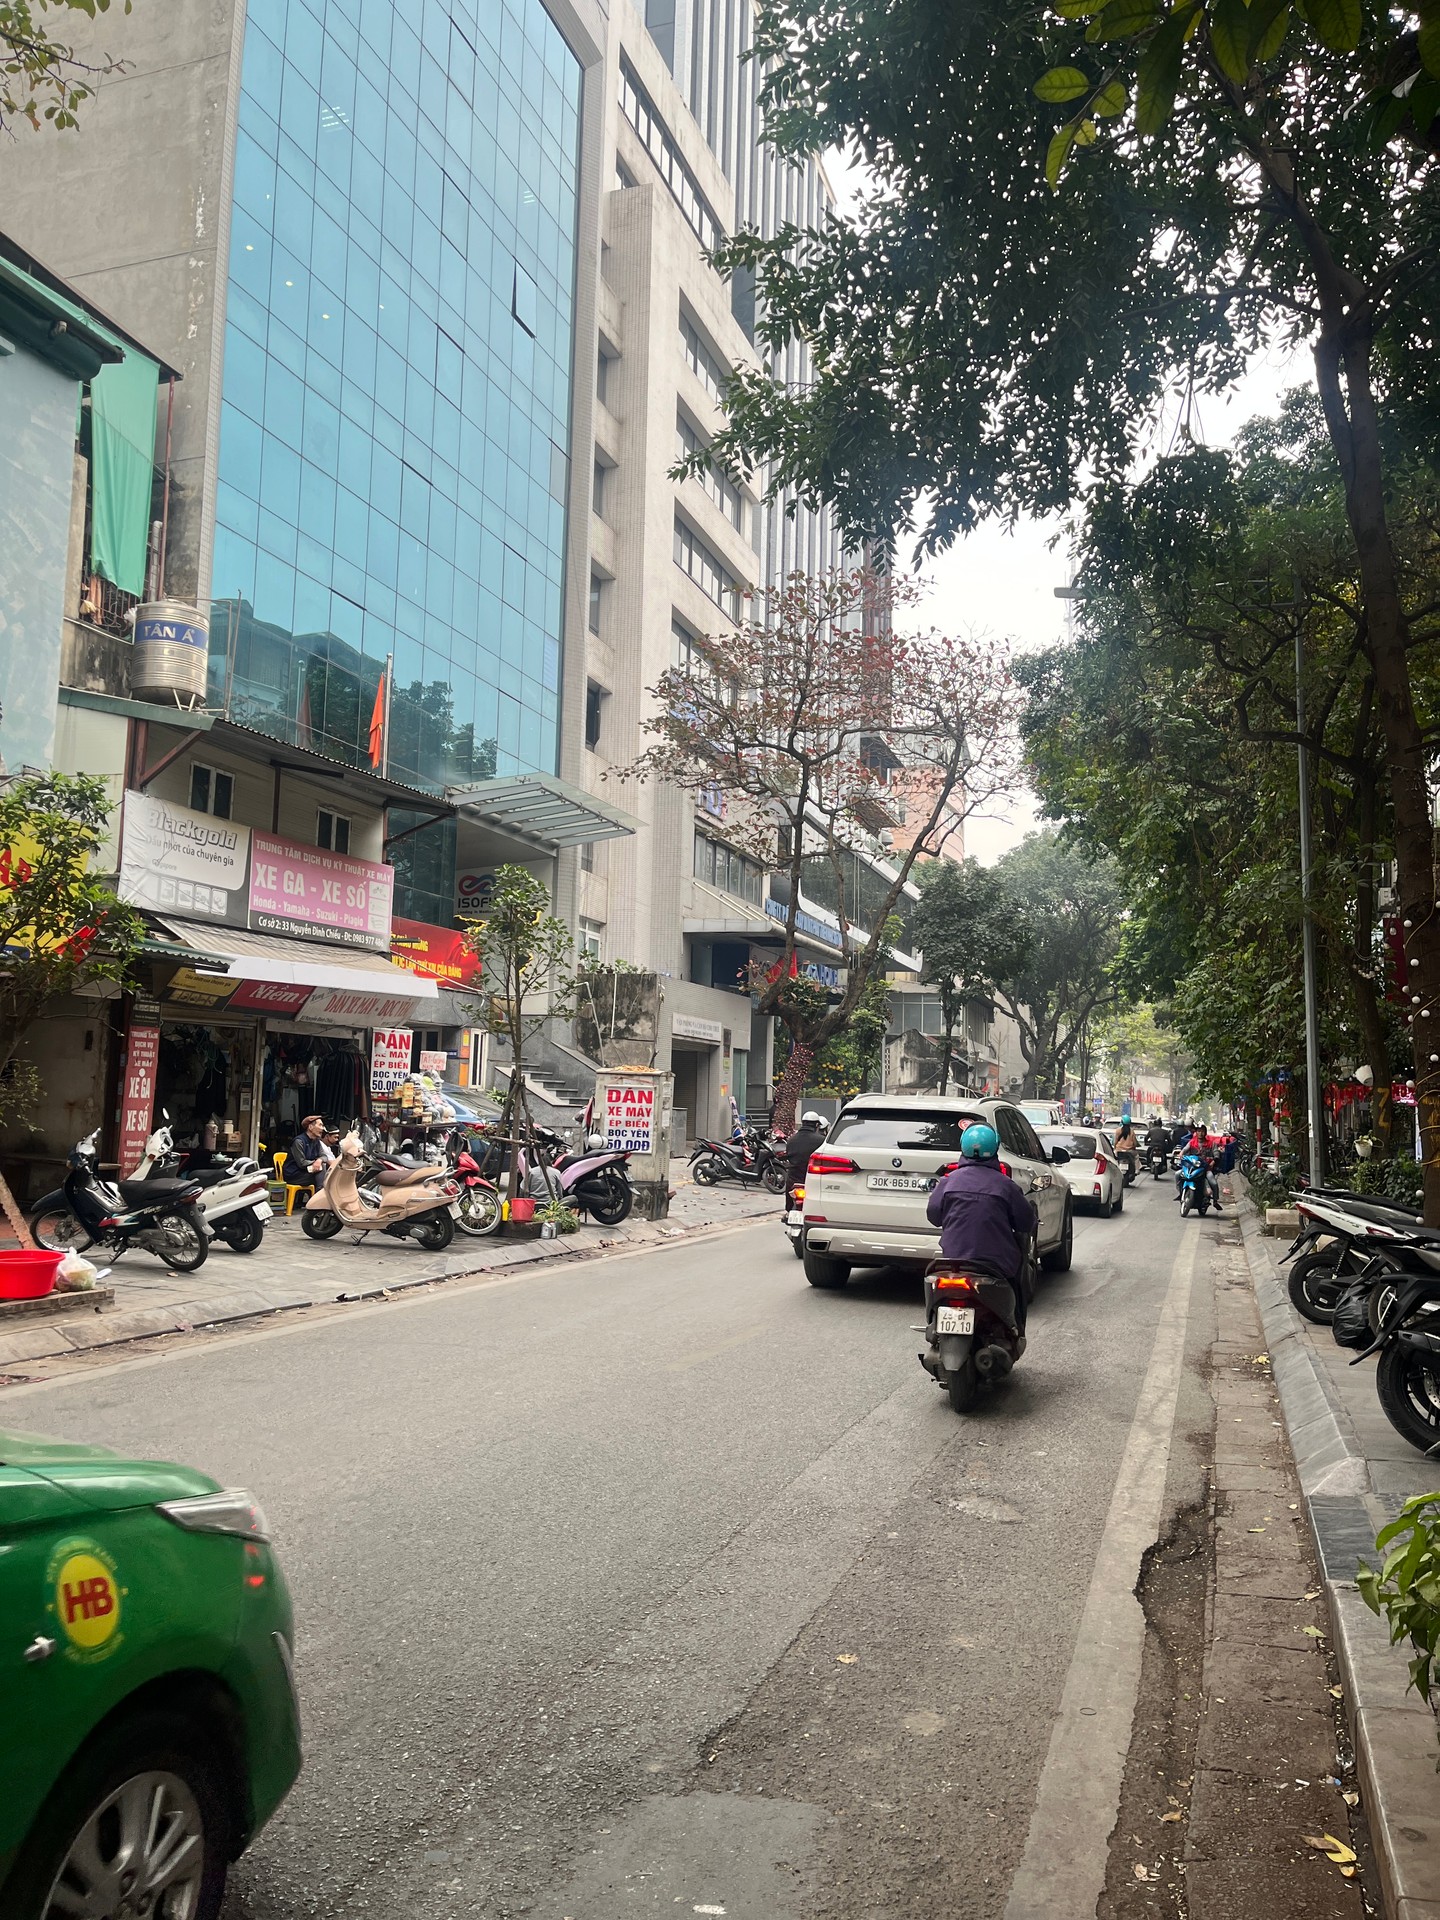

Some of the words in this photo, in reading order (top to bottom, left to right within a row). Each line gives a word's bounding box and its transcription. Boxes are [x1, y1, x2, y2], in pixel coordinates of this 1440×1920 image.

[196, 848, 222, 864] chuyên
[223, 855, 234, 866] gia
[256, 840, 282, 855] TRUNG
[285, 846, 302, 860] TÂM
[303, 853, 321, 866] DỊCH
[344, 863, 366, 877] THUẬT
[366, 869, 376, 879] XE
[377, 871, 391, 882] MÁY
[254, 862, 278, 890] XE
[283, 870, 305, 897] GA
[321, 879, 342, 905] XE
[346, 881, 367, 910] SỐ
[253, 895, 277, 910] Honda
[283, 901, 310, 916] Yamaha
[316, 908, 338, 922] Suzuki
[344, 914, 364, 927] Piagio
[282, 920, 290, 931] 33
[249, 984, 299, 1004] Niềm
[373, 1070, 390, 1079] BỌC
[129, 1077, 140, 1098] XE
[140, 1077, 151, 1098] GA
[607, 1087, 653, 1104] DÁN
[126, 1110, 137, 1131] XE
[137, 1103, 150, 1132] SỐ
[608, 1106, 622, 1116] XE
[626, 1105, 652, 1117] MÁY
[609, 1118, 622, 1126] ÉP
[608, 1129, 627, 1139] BỌC
[631, 1129, 649, 1138] YÊN
[64, 1577, 113, 1624] HB
